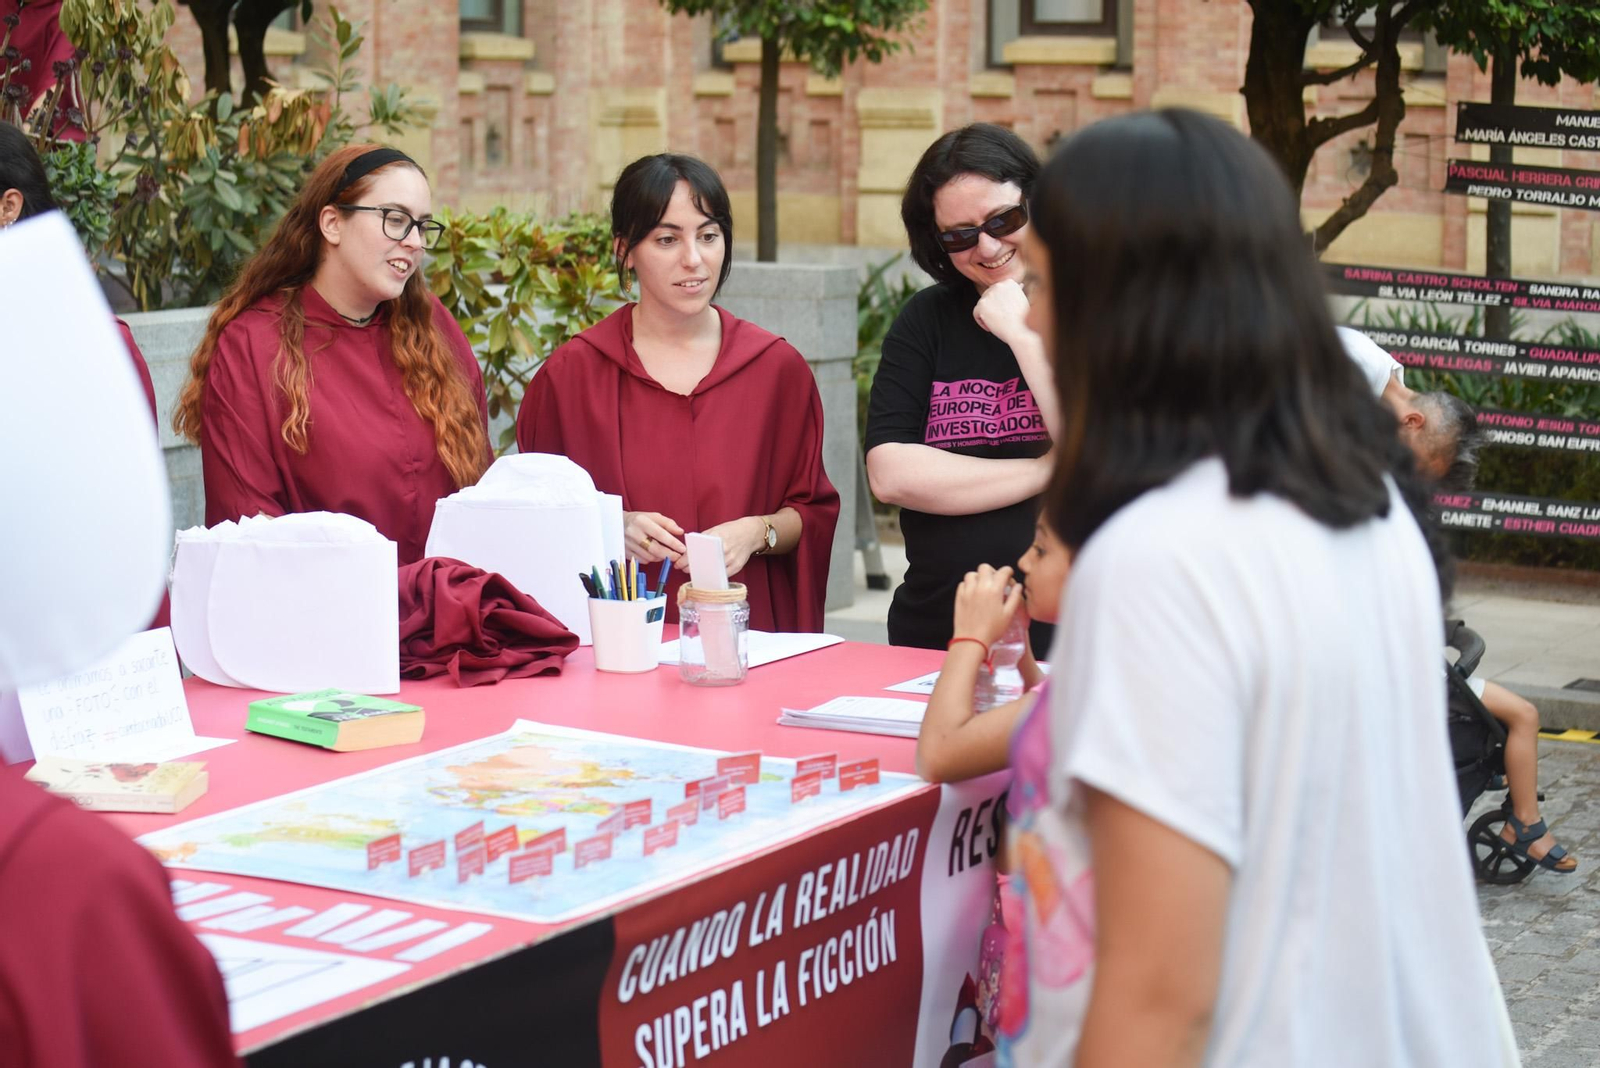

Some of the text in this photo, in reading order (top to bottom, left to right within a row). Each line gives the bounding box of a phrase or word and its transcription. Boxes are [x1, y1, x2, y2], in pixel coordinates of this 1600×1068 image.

[1464, 127, 1505, 143] MARÍA
[1449, 163, 1509, 183] PASCUAL
[1512, 170, 1572, 187] HERRERA
[1467, 184, 1512, 199] PEDRO
[1515, 189, 1586, 206] TORRALBO
[1344, 267, 1394, 283] SABRINA
[1397, 272, 1449, 288] CASTRO
[1451, 278, 1519, 293] SCHOLTEN
[1529, 283, 1580, 299] SANDRA
[1378, 285, 1417, 300] SILVIA
[1513, 296, 1552, 309] SILVIA
[1464, 340, 1517, 357] TORRES
[1428, 354, 1493, 372] VILLEGAS
[1503, 361, 1547, 377] JAVIER
[932, 381, 1015, 398] LA NOCHE
[930, 401, 1002, 419] EUROPEA
[1007, 394, 1026, 411] DE
[1476, 412, 1534, 428] ANTONIO
[1537, 434, 1566, 448] SAN
[1567, 436, 1600, 452] EUFR
[1482, 498, 1543, 516] EMANUEL
[1547, 504, 1581, 519] SANZ
[1503, 518, 1555, 533] ESTHER
[617, 828, 920, 1003] CUANDO LA REALIDAD
[635, 907, 898, 1068] SUPERA LA FICCIÓN
